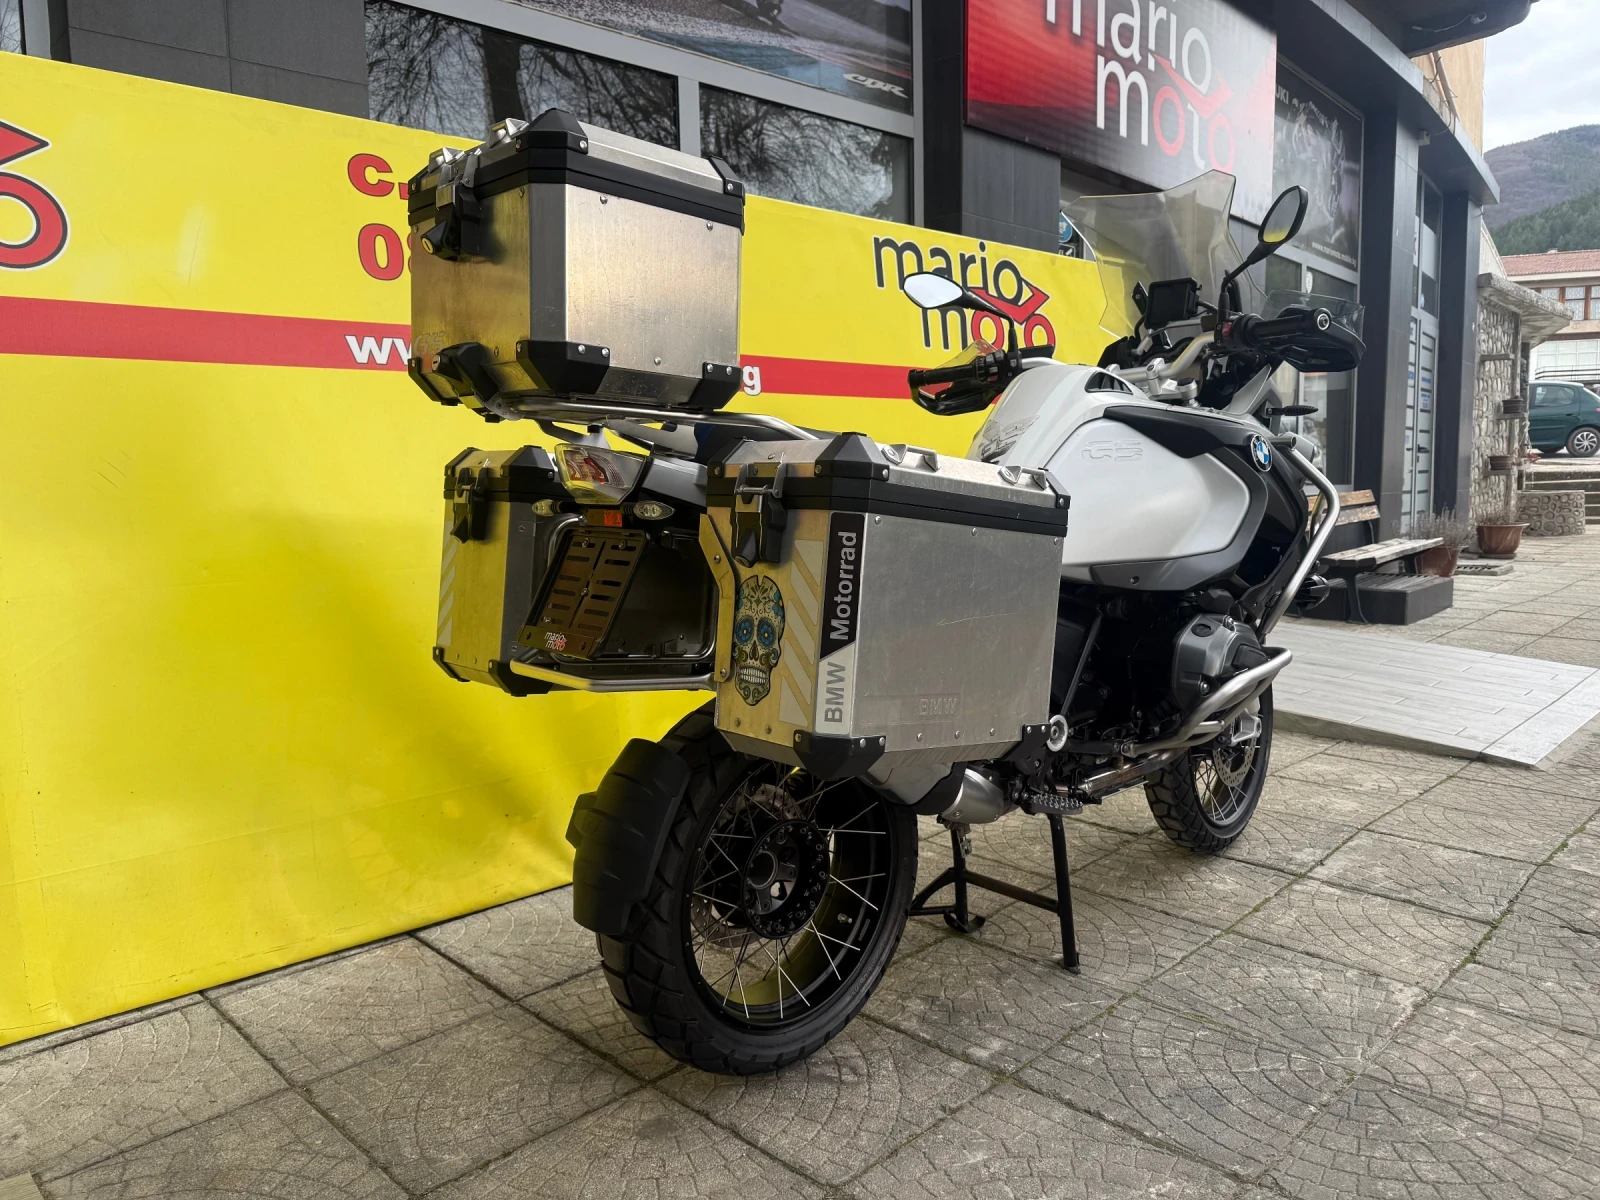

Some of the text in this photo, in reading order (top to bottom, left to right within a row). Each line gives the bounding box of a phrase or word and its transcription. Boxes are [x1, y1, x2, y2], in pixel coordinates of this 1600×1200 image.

[1096, 54, 1236, 174] moto
[824, 531, 857, 723] BMW Motorrad
[918, 697, 957, 716] BMW
